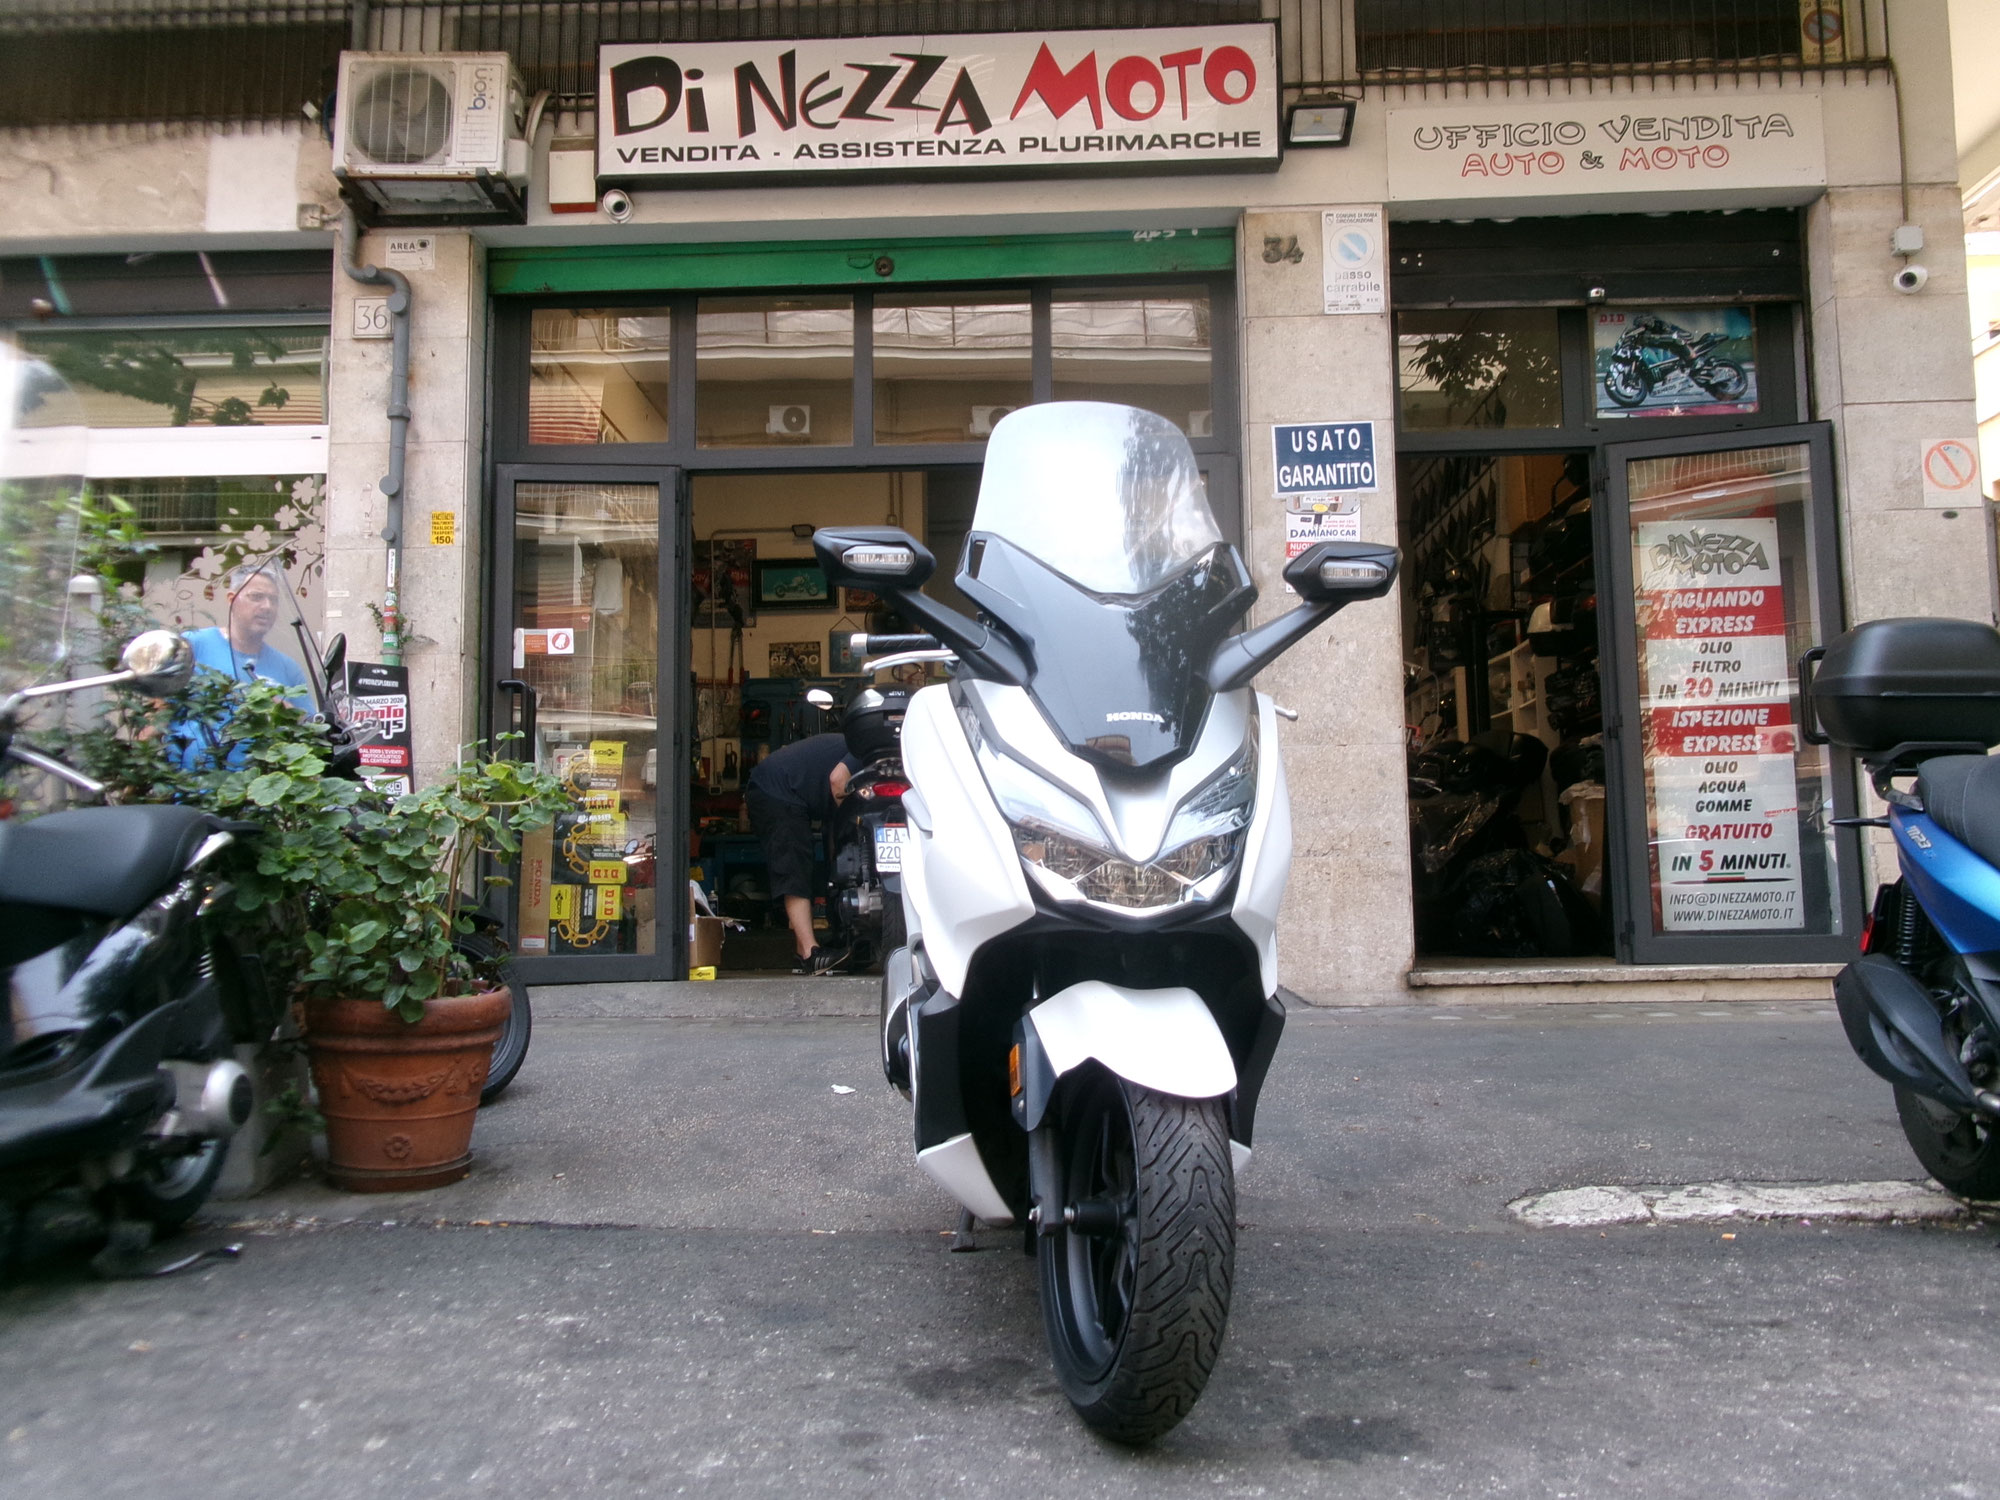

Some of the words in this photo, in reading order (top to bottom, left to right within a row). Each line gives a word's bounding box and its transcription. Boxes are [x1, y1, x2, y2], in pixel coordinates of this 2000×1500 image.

[467, 68, 487, 111] bion
[1009, 41, 1257, 130] MOTO
[1413, 120, 1587, 151] UFFICIO
[1599, 112, 1795, 143] VENDITA
[617, 143, 760, 164] VENDITA
[794, 139, 1006, 162] ASSISTENZA
[1019, 131, 1262, 154] PLURIMARCHE
[1461, 150, 1566, 177] AUTO
[1579, 150, 1604, 171] &
[1619, 144, 1731, 171] MOTO
[390, 242, 415, 250] AREA
[1262, 236, 1304, 264] 34
[1335, 271, 1371, 282] passo
[1326, 282, 1380, 292] carrabile
[355, 305, 389, 329] 36
[1599, 313, 1626, 323] DID
[1291, 428, 1361, 452] USATO
[1279, 462, 1373, 487] GARANTITO
[1290, 529, 1338, 539] DAMIANO
[1662, 590, 1764, 609] TAGLIANDO
[1675, 615, 1755, 634] EXPRESS
[1700, 641, 1732, 654] OLIO
[1692, 660, 1741, 673] FILTRO
[1659, 684, 1677, 699] IN
[1684, 677, 1713, 699] 20
[1718, 681, 1780, 698] MINUTI
[1106, 712, 1165, 723] HONDA
[1672, 708, 1770, 727] ISPEZIONE
[1683, 734, 1762, 753] EXPRESS
[1704, 761, 1738, 774] OLIO
[1698, 780, 1746, 794] ACQUA
[1695, 799, 1752, 812] GOMME
[885, 828, 900, 843] FA
[1685, 823, 1773, 841] GRATUITO
[1672, 856, 1692, 872] IN
[1698, 850, 1714, 872] 5
[593, 868, 619, 879] DID
[533, 859, 543, 908] HONDA
[604, 889, 615, 916] DID
[1669, 891, 1796, 906] INFO@DINEZZAMOTO.IT
[1673, 908, 1794, 922] WWW.DINEZZAMOTO.IT
